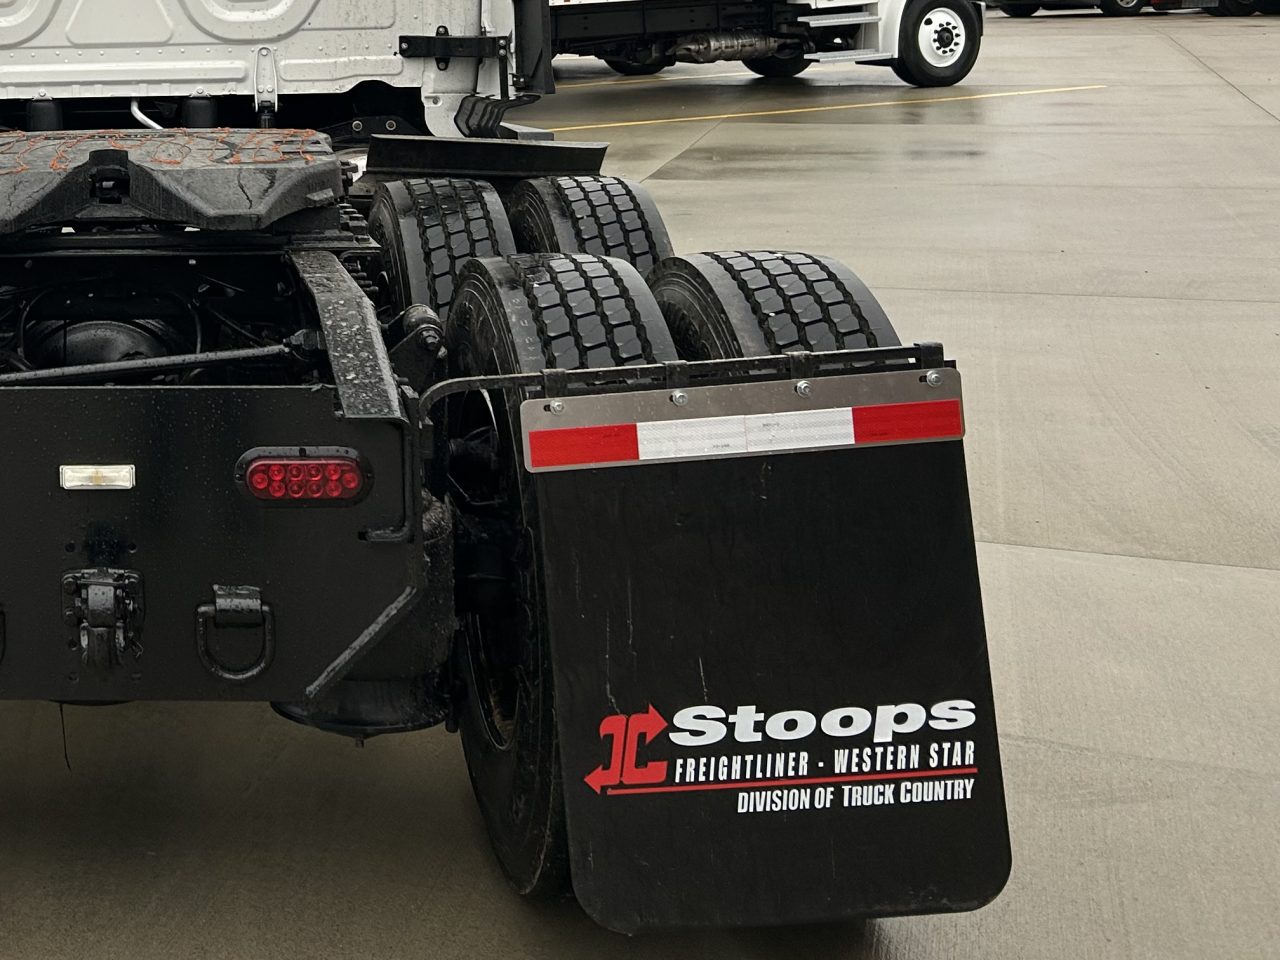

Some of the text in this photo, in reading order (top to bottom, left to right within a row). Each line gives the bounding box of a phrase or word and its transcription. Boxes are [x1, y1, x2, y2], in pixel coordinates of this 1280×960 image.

[668, 699, 976, 747] Stoops
[674, 740, 975, 783] FREIGHTLINER WESTERN STAR
[737, 778, 975, 814] DIVISION OF TRUCK COUNTRY
